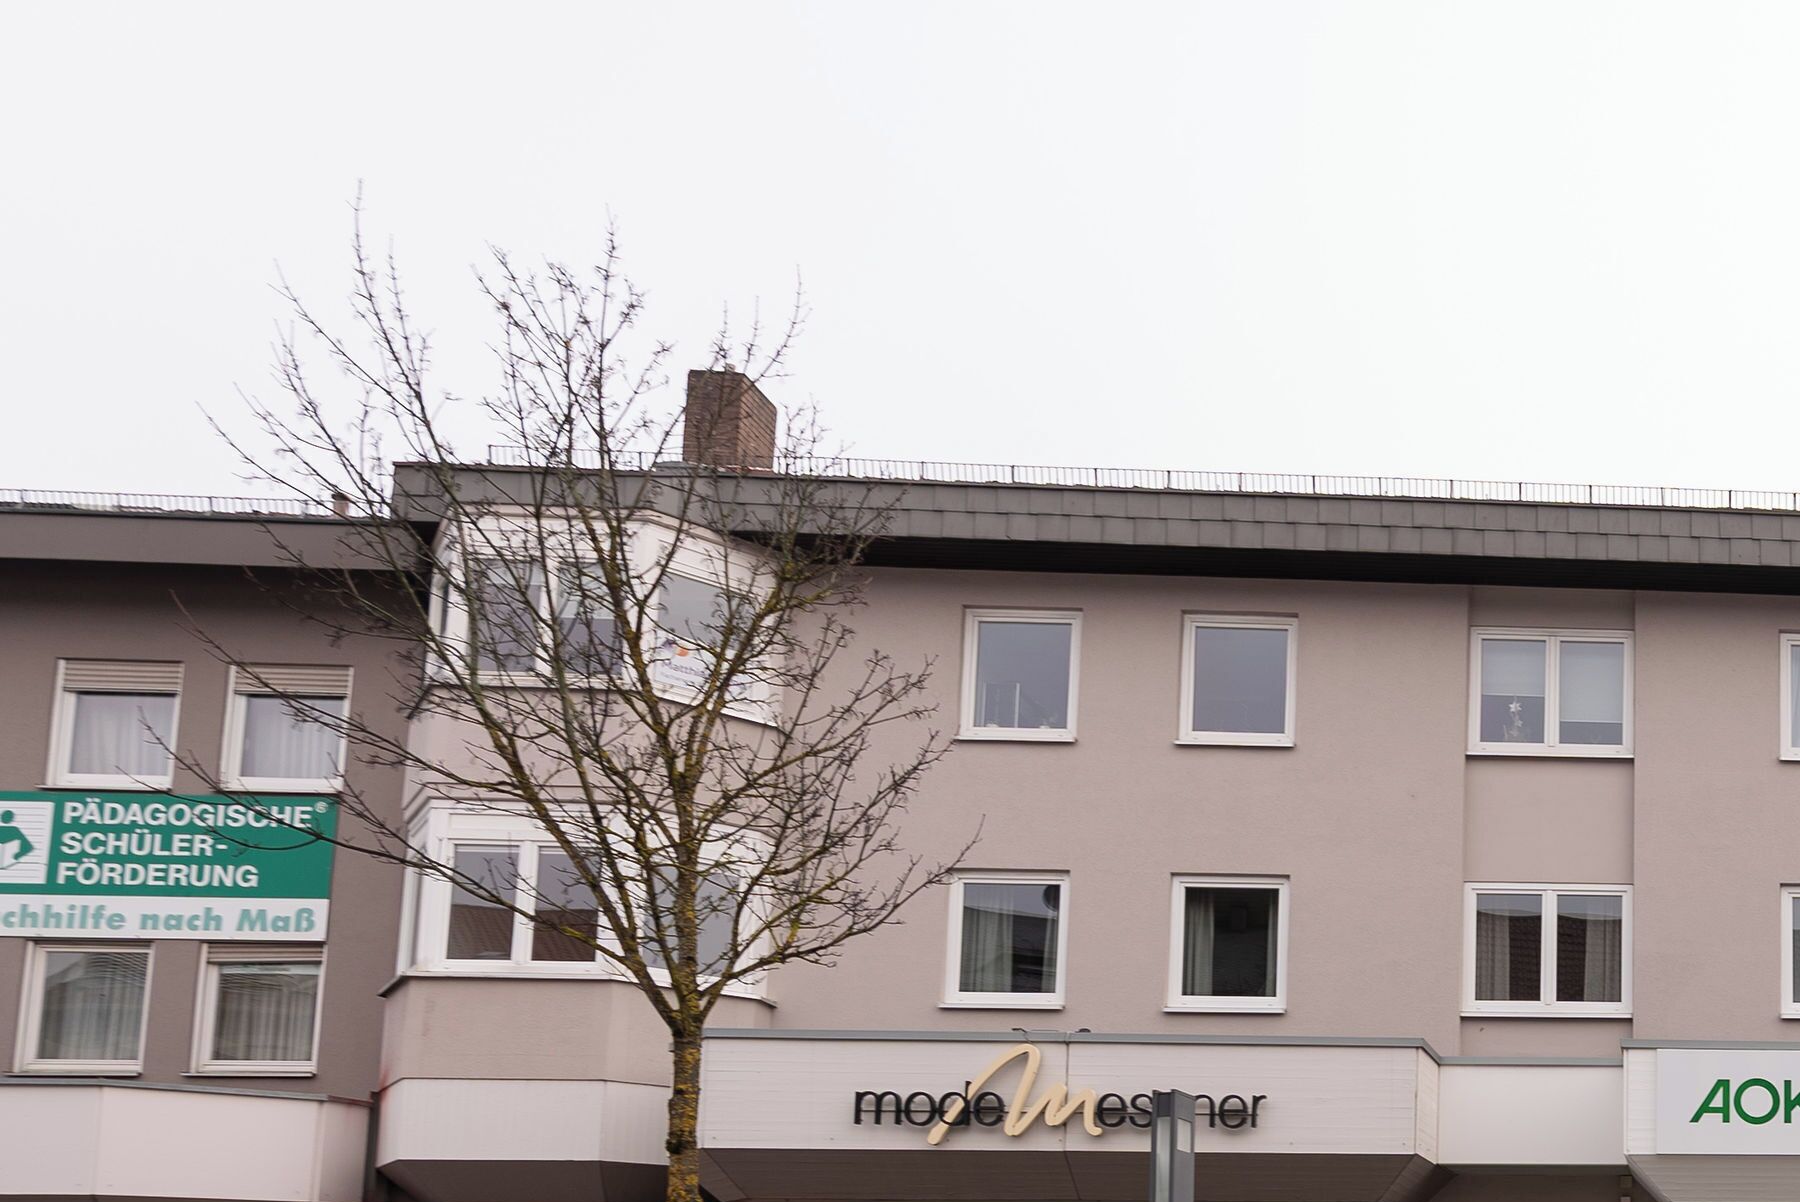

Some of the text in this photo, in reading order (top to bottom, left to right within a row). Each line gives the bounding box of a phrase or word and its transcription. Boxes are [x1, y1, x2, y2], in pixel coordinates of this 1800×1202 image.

[62, 798, 313, 829] PÄDAGOGISCHE
[60, 830, 228, 857] SCHÜLER-
[57, 862, 260, 888] FÖRDERUNG
[2, 903, 316, 933] chhilfe nach Maß
[853, 1081, 1004, 1127] mode
